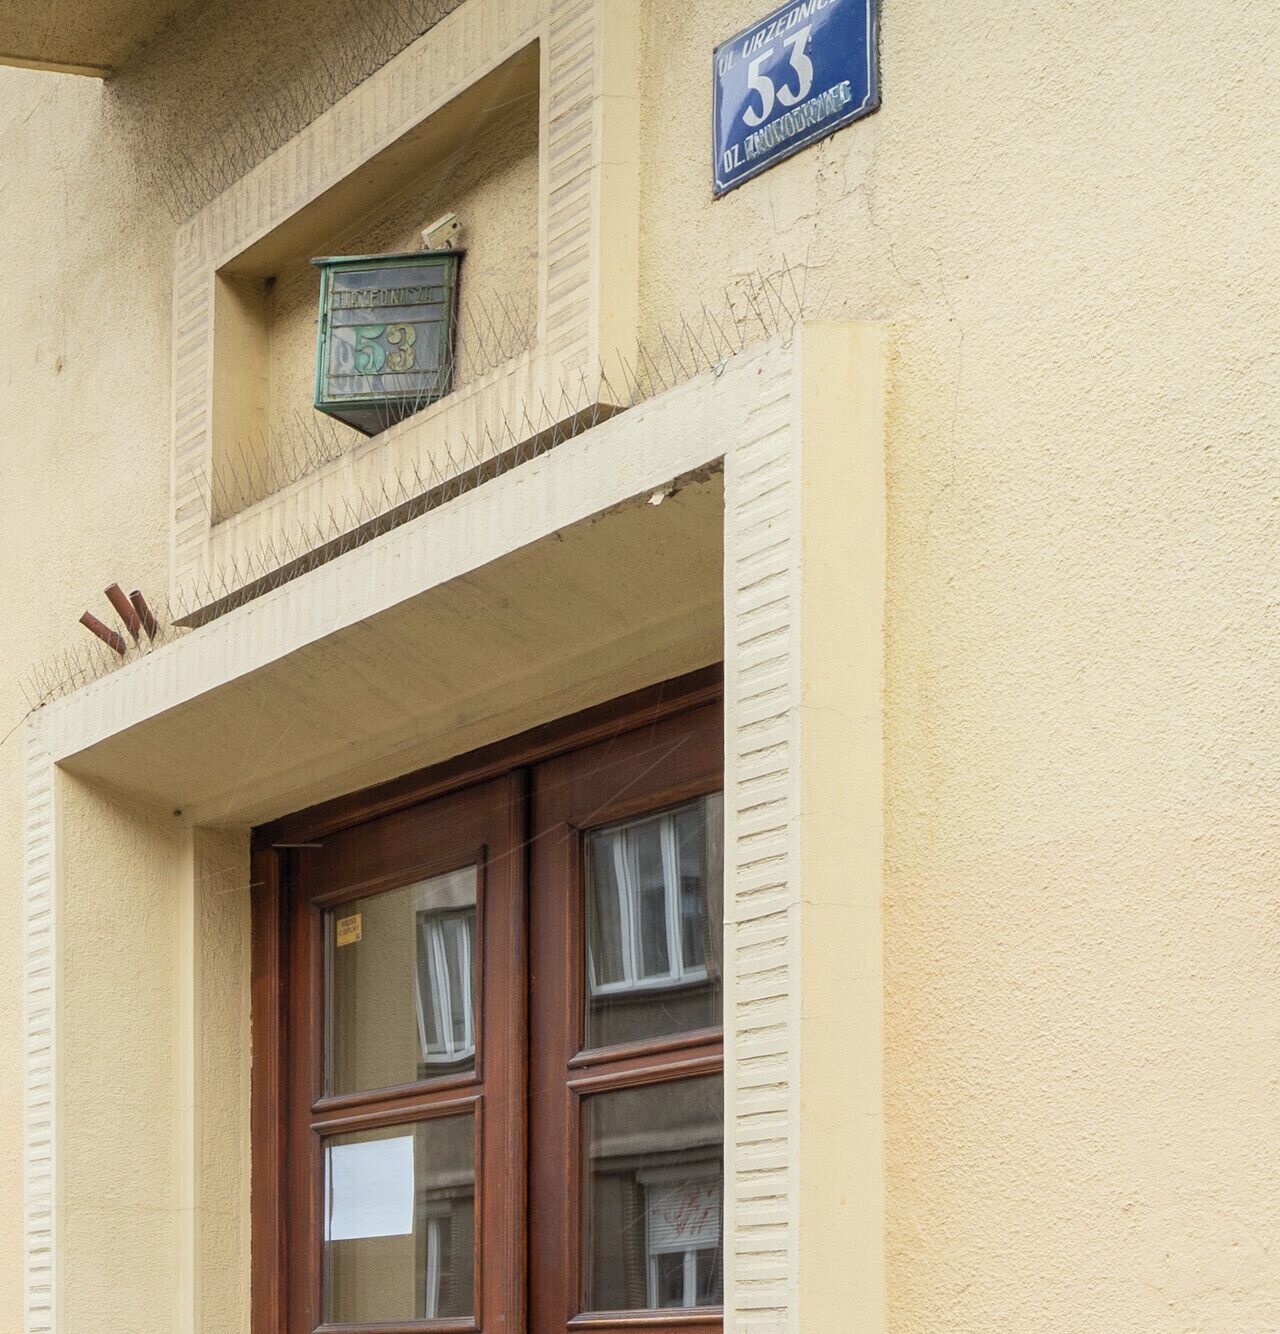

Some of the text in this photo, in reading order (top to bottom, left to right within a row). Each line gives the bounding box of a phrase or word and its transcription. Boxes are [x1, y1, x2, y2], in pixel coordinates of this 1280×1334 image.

[742, 0, 836, 59] URZĘDNIC
[742, 24, 814, 127] 53
[354, 323, 417, 374] 53
